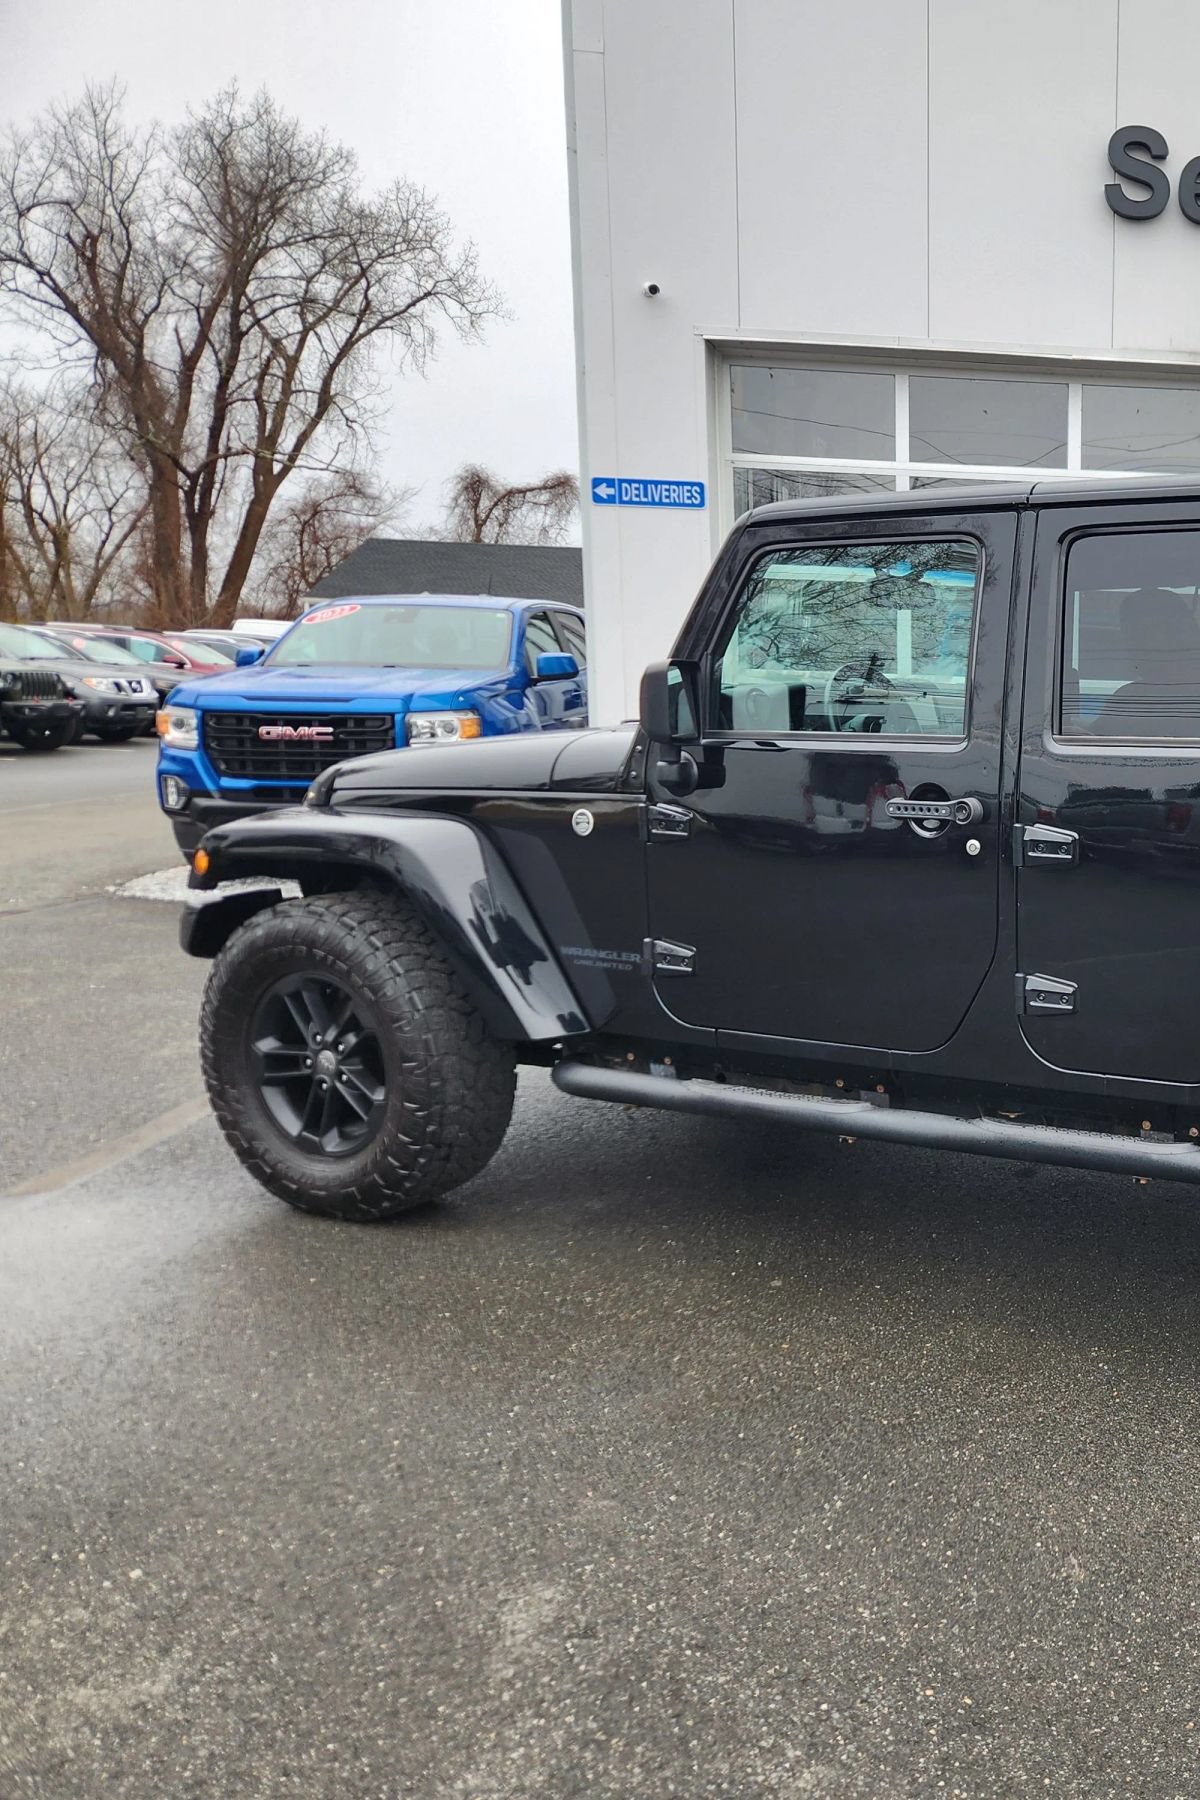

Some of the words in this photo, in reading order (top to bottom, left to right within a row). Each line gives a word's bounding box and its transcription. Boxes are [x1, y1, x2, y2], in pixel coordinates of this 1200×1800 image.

[621, 482, 701, 505] DELIVERIES
[259, 726, 335, 741] GMC
[559, 946, 641, 963] WRANGLER
